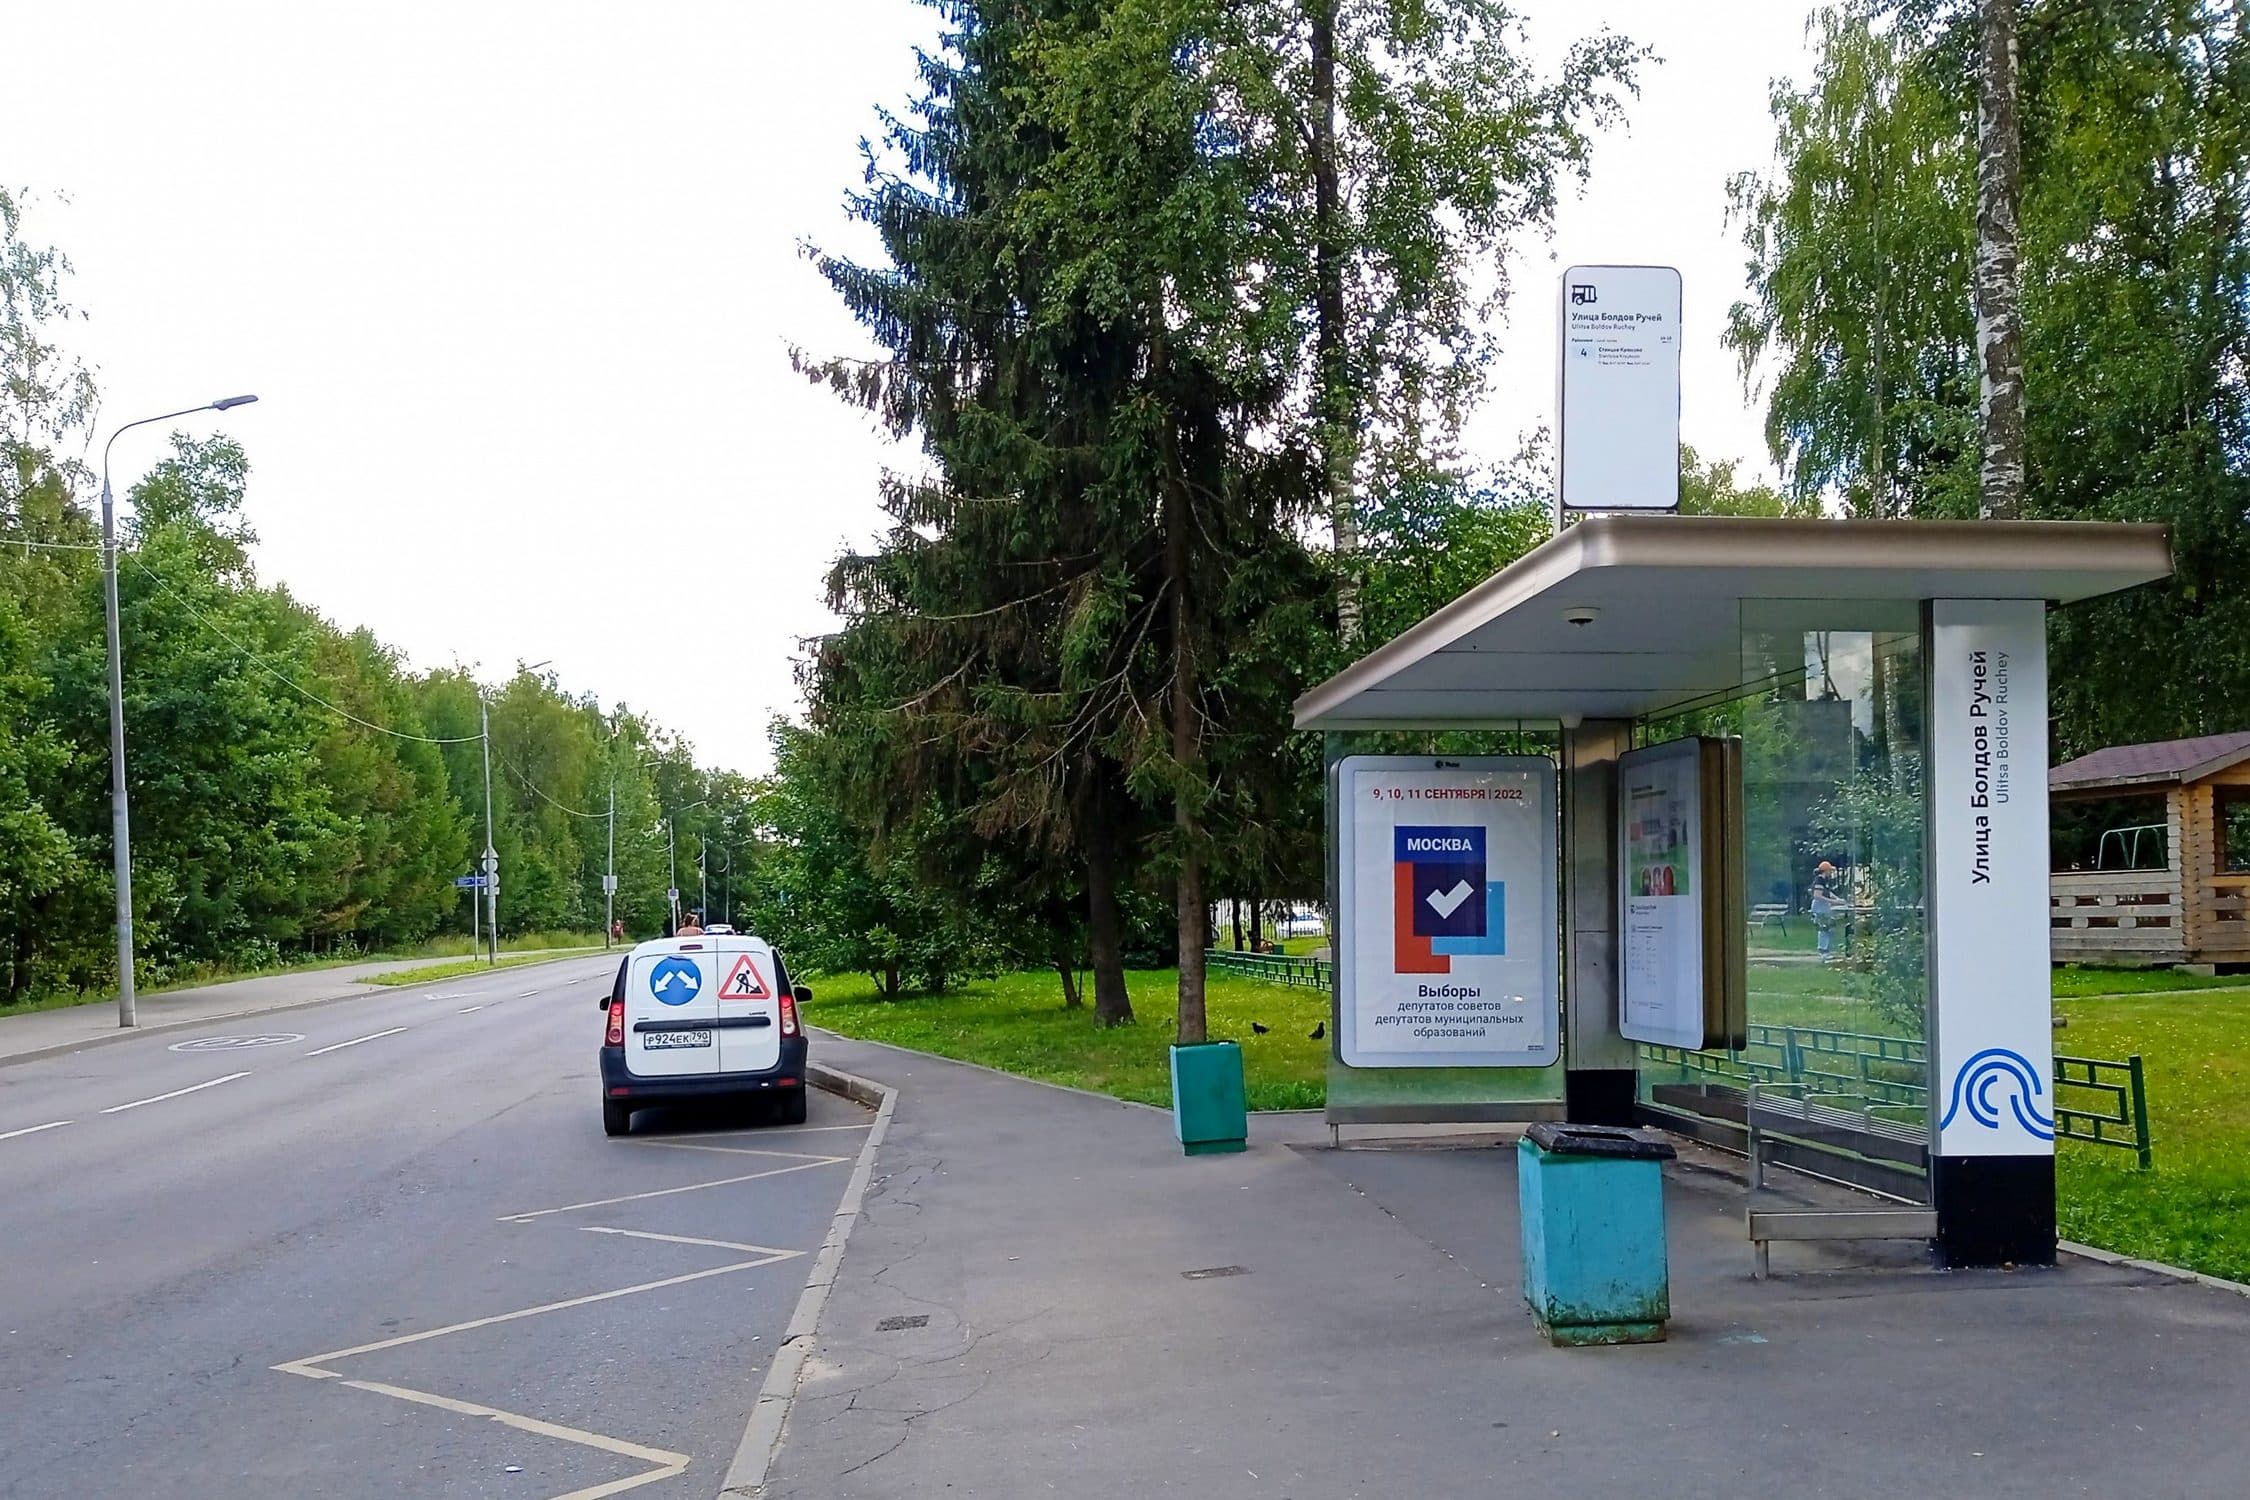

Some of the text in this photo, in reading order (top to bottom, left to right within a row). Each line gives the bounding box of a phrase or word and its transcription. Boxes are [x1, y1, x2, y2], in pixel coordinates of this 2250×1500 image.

[1571, 312, 1662, 323] Улица Болдов Ручей
[1580, 347, 1587, 357] 4
[1995, 651, 2010, 803] Ulitsa Boldov Ruchey
[1969, 651, 1991, 884] Улица Болдов Ручей
[1373, 788, 1523, 800] 9, 10, 11 СЕНТЯБРЯ 2022
[1407, 838, 1473, 851] МОСКВА
[1418, 984, 1480, 1000] Выборы
[1397, 1002, 1501, 1013] депутатов советов
[1375, 1015, 1524, 1026] депутатов муниципальных
[1413, 1027, 1486, 1039] образований
